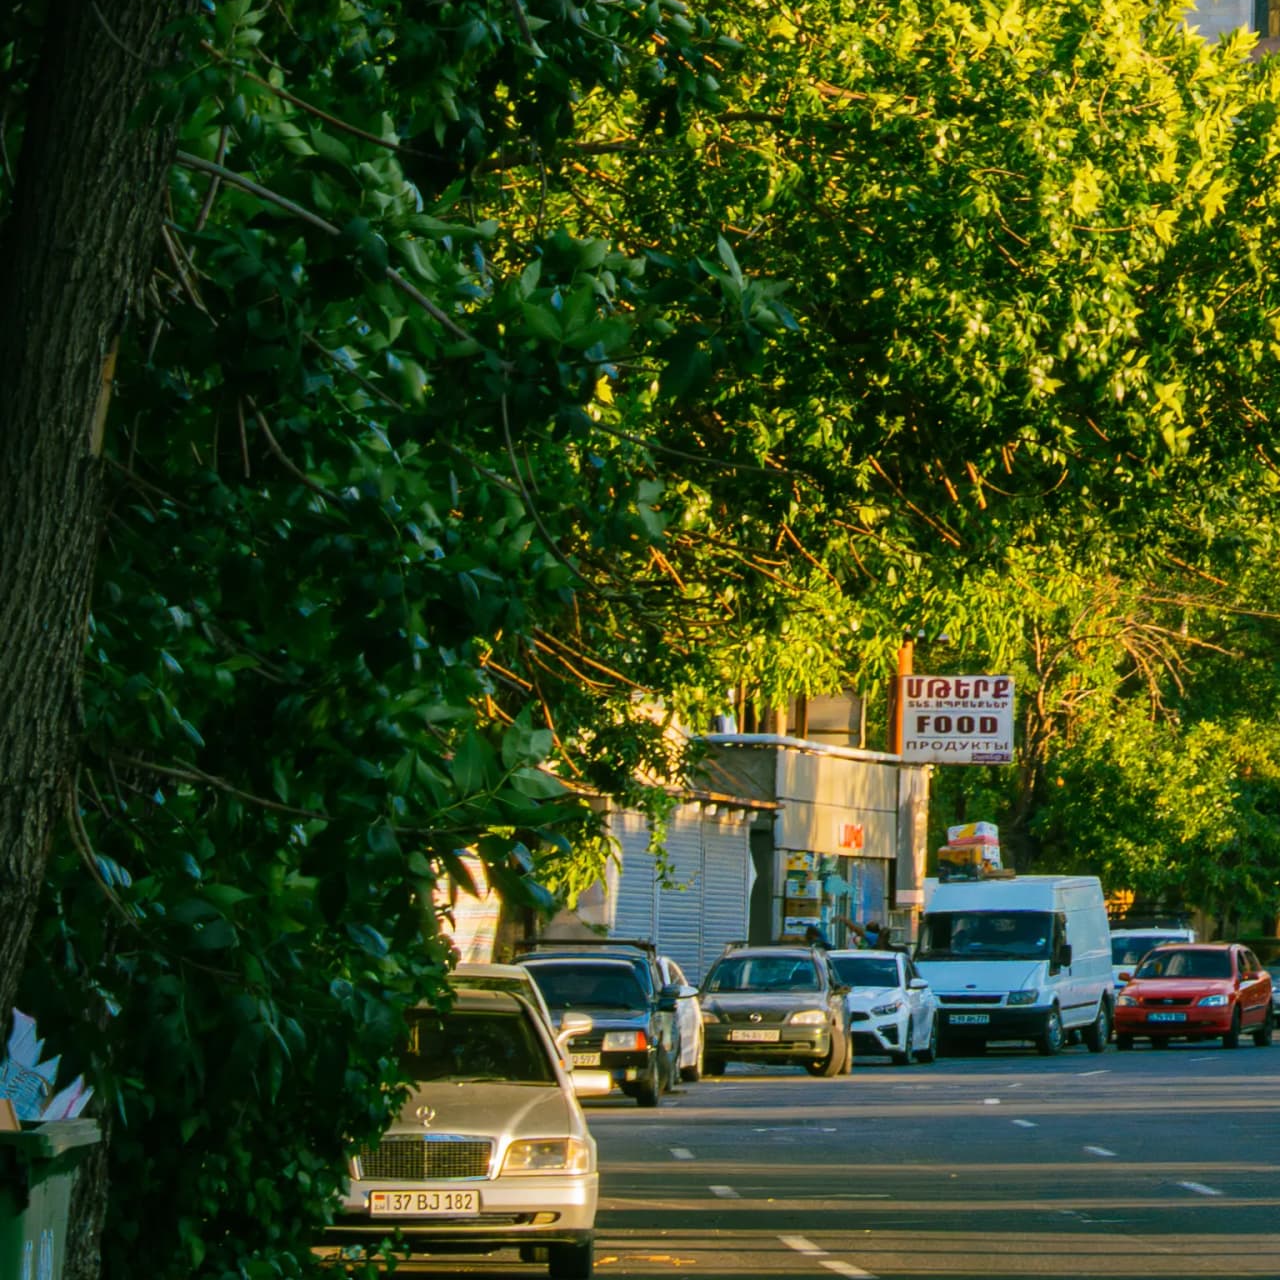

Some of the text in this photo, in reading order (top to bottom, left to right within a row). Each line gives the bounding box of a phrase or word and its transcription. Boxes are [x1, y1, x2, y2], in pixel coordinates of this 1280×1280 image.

[907, 678, 1009, 699] ՄԹԵՐՔ
[917, 715, 998, 734] FOOD
[906, 741, 1009, 752] ПРОДУКТЫ
[393, 1194, 412, 1210] 37
[417, 1193, 440, 1210] BJ
[445, 1194, 473, 1210] 182
